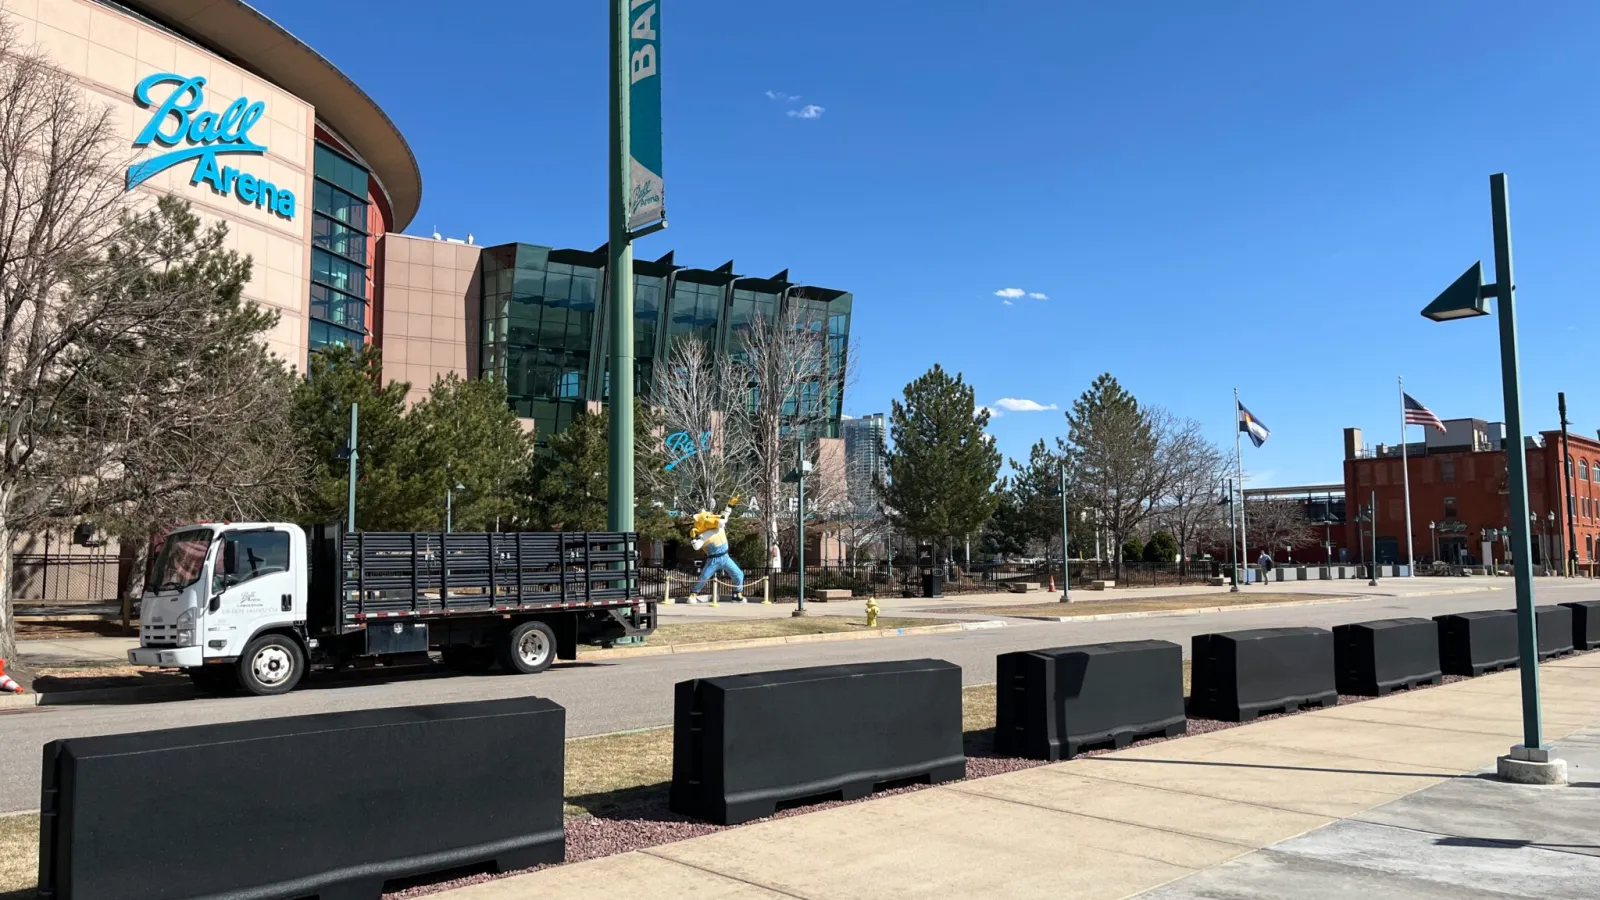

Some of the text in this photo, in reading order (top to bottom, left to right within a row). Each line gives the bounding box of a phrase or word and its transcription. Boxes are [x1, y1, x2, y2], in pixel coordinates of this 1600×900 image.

[631, 0, 656, 86] BA
[132, 72, 268, 152] Ball
[191, 151, 296, 219] Arena
[632, 180, 652, 204] Ball
[640, 194, 660, 208] Arena
